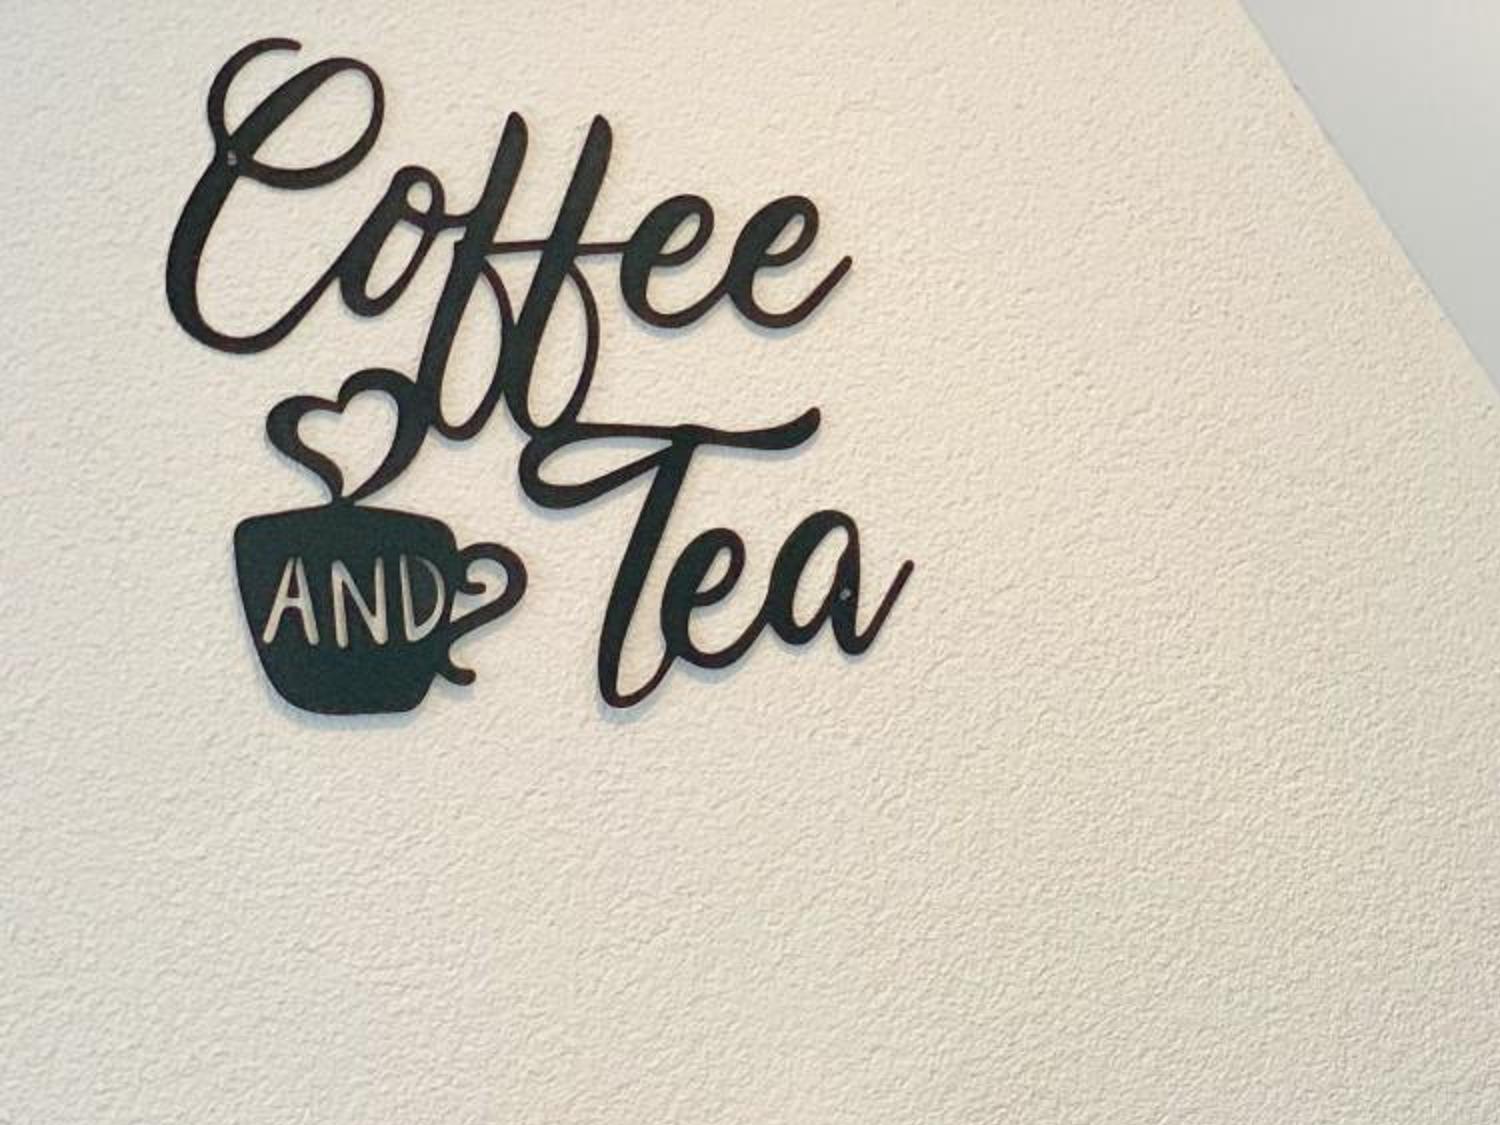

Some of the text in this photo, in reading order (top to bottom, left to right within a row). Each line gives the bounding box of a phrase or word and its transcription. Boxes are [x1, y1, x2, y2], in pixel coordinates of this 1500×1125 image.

[165, 37, 853, 441] Coffee
[263, 556, 447, 647] AND
[519, 407, 914, 708] Tea
